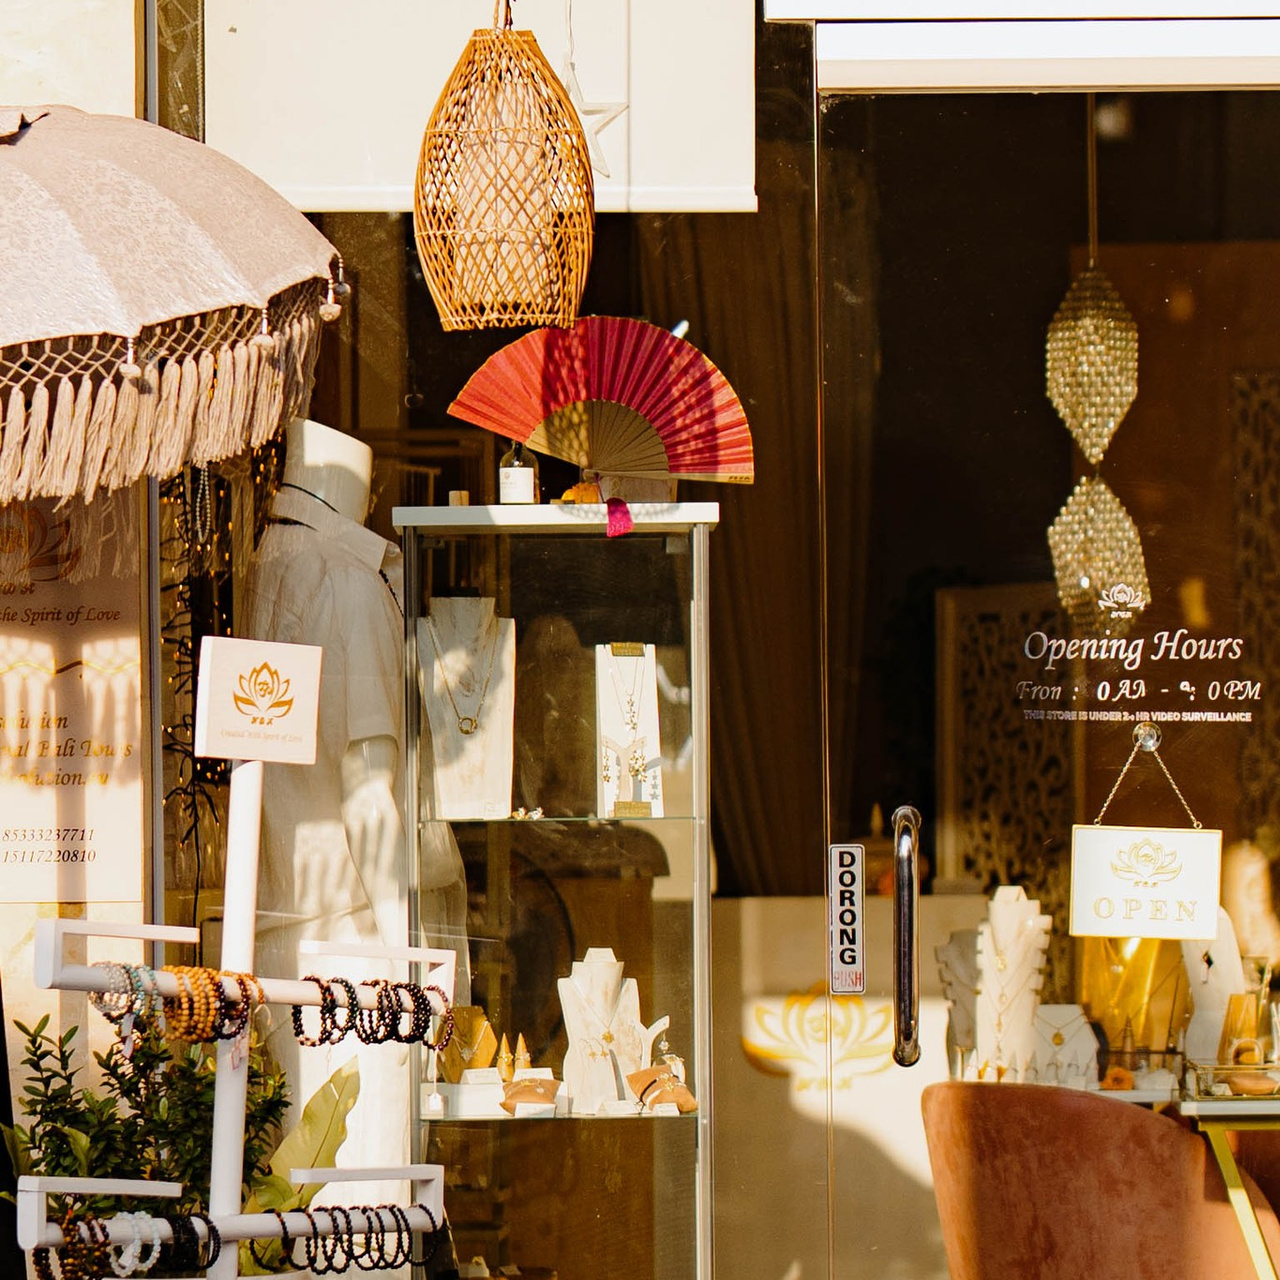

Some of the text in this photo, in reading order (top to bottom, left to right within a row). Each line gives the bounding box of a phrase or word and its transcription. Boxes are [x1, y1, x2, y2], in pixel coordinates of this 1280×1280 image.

[21, 606, 62, 625] Spirit
[66, 605, 84, 625] of
[84, 607, 121, 621] Love
[1024, 628, 1244, 670] Opening Hours
[1023, 709, 1044, 719] THIS
[1046, 710, 1077, 720] STORE
[1078, 710, 1088, 720] IS
[1089, 710, 1122, 721] UNDER
[1135, 711, 1150, 721] HR
[1151, 711, 1181, 721] VIDEO
[1181, 711, 1252, 722] SURVEILLANCE
[80, 740, 132, 757] Tous
[839, 851, 857, 965] DORONG
[1093, 897, 1199, 922] OPEN
